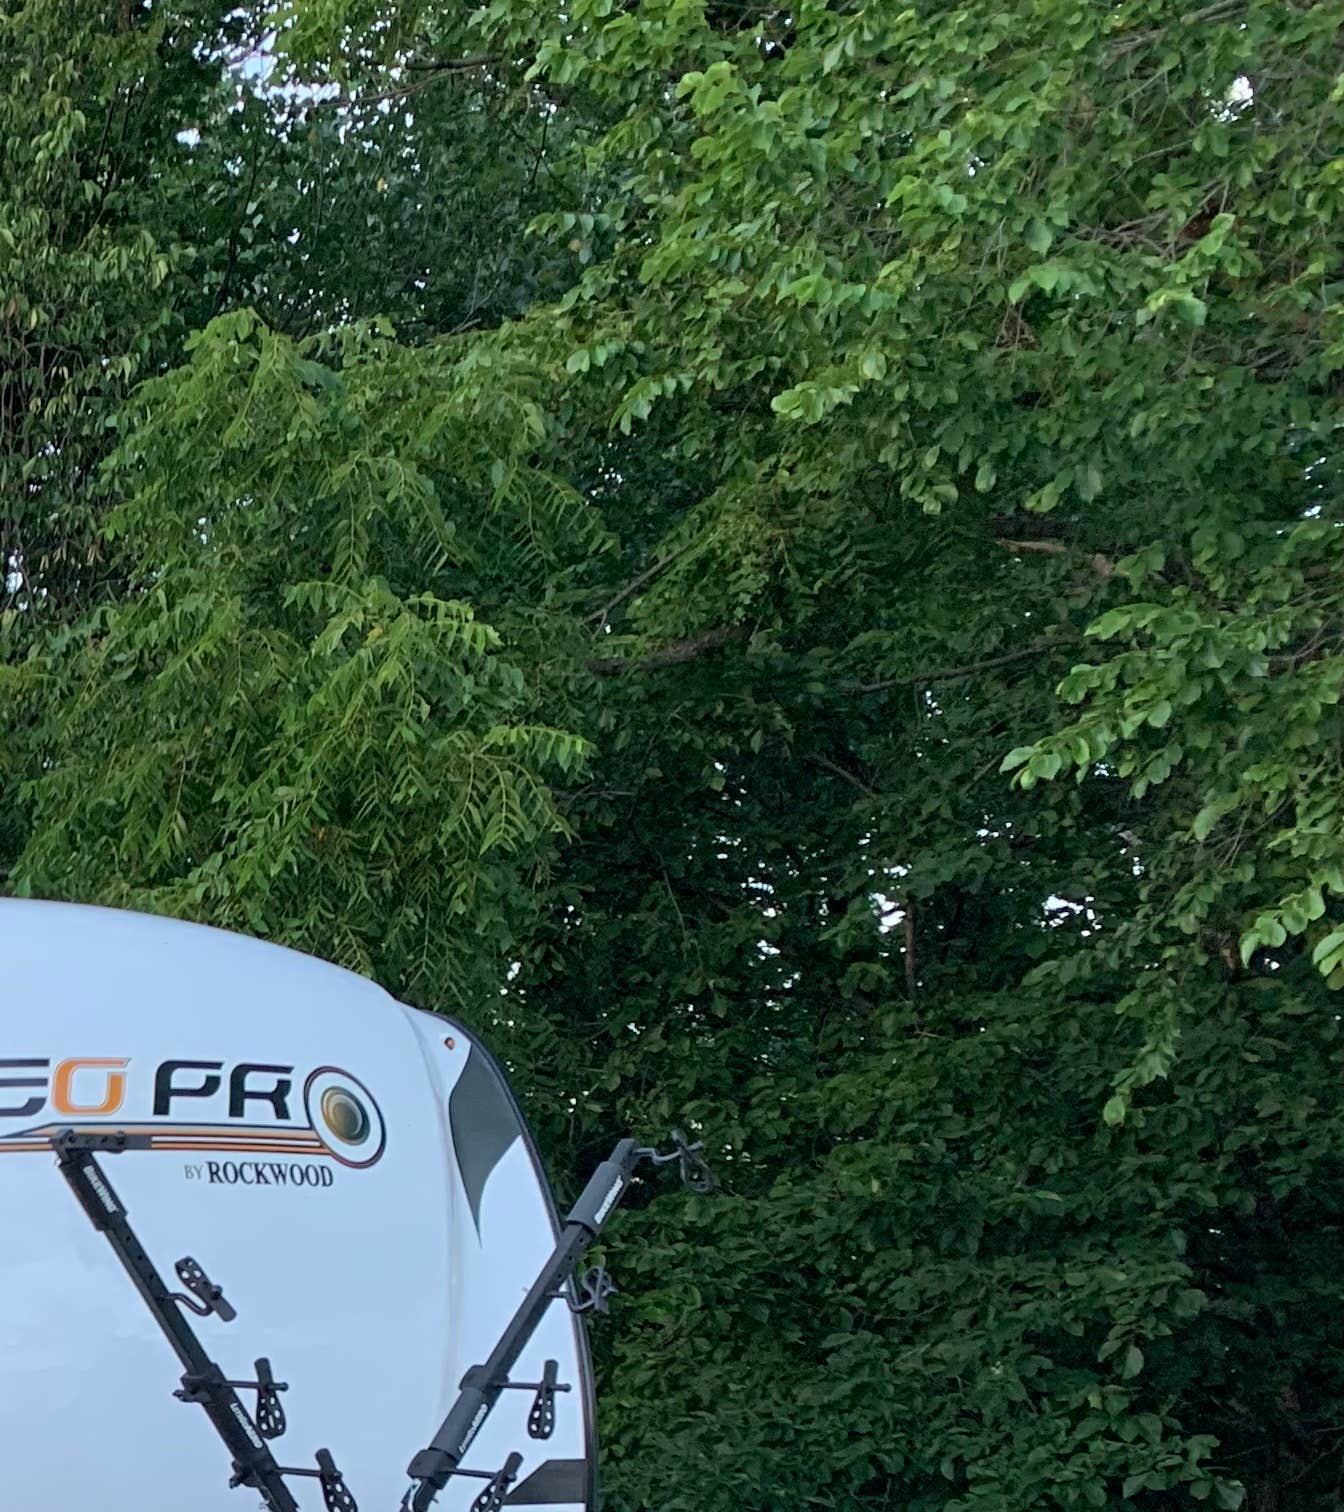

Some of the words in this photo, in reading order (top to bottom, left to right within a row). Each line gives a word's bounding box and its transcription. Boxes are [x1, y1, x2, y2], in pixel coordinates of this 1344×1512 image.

[152, 1060, 386, 1169] PRO
[184, 1164, 203, 1180] BY
[206, 1160, 334, 1187] ROCKWOOD
